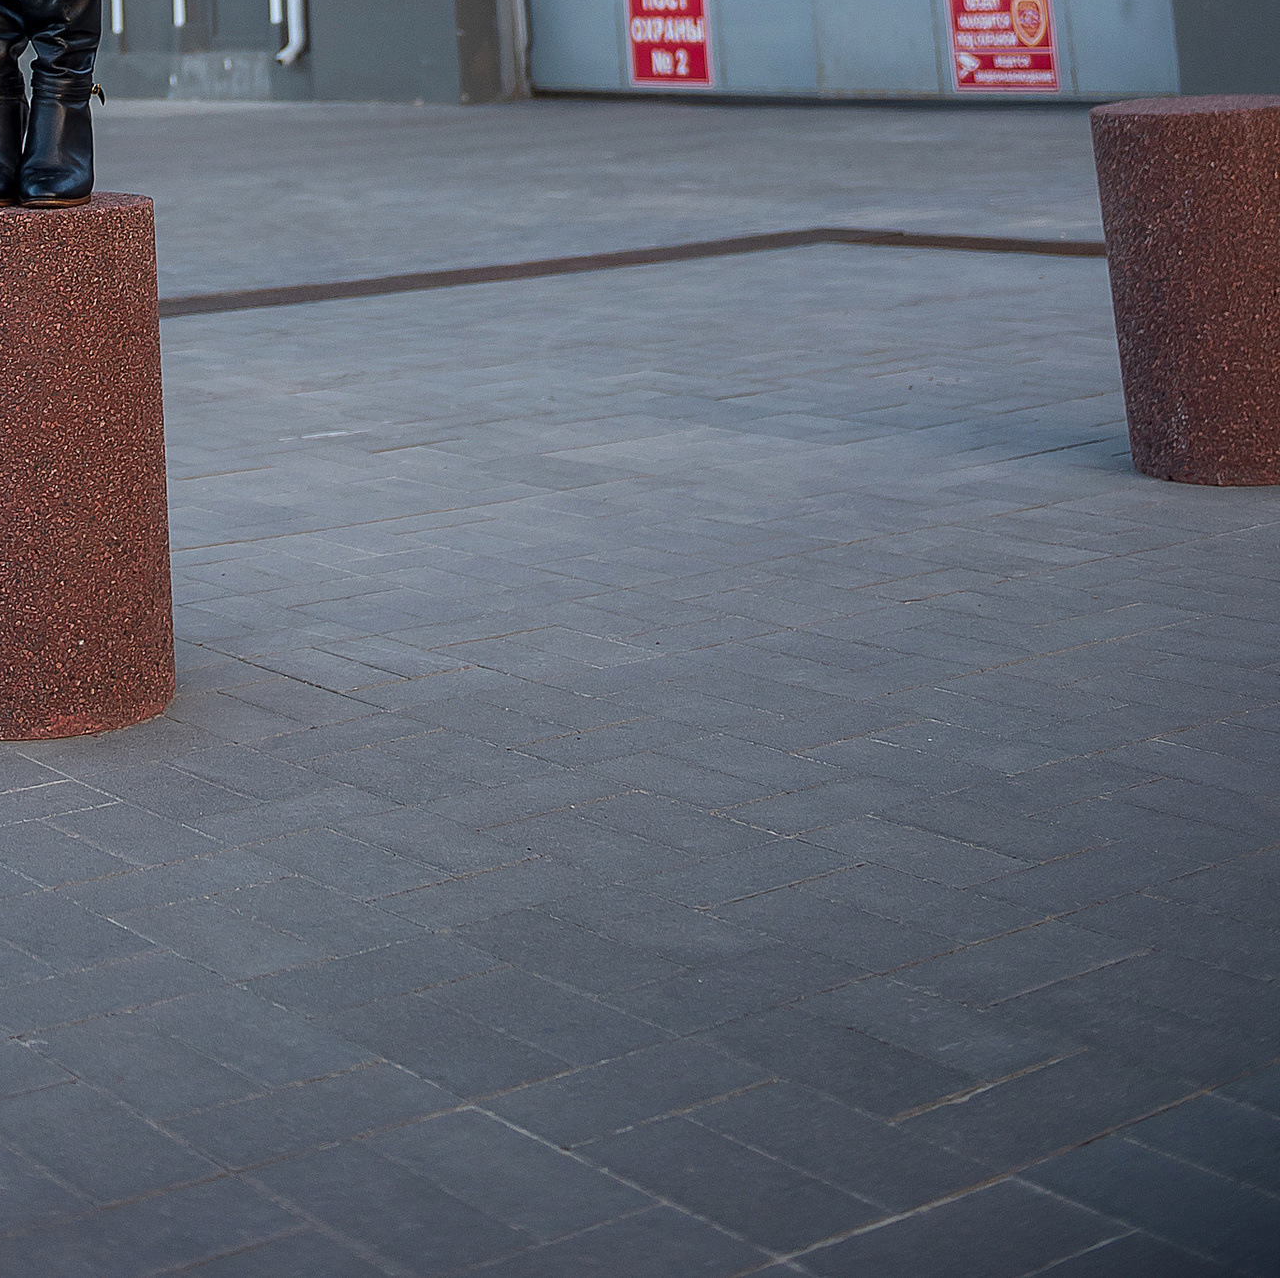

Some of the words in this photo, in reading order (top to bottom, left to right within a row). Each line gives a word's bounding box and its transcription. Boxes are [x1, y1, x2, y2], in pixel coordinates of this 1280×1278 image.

[631, 15, 705, 43] ОХРАНЫ
[651, 48, 674, 76] №
[675, 47, 689, 76] 2
